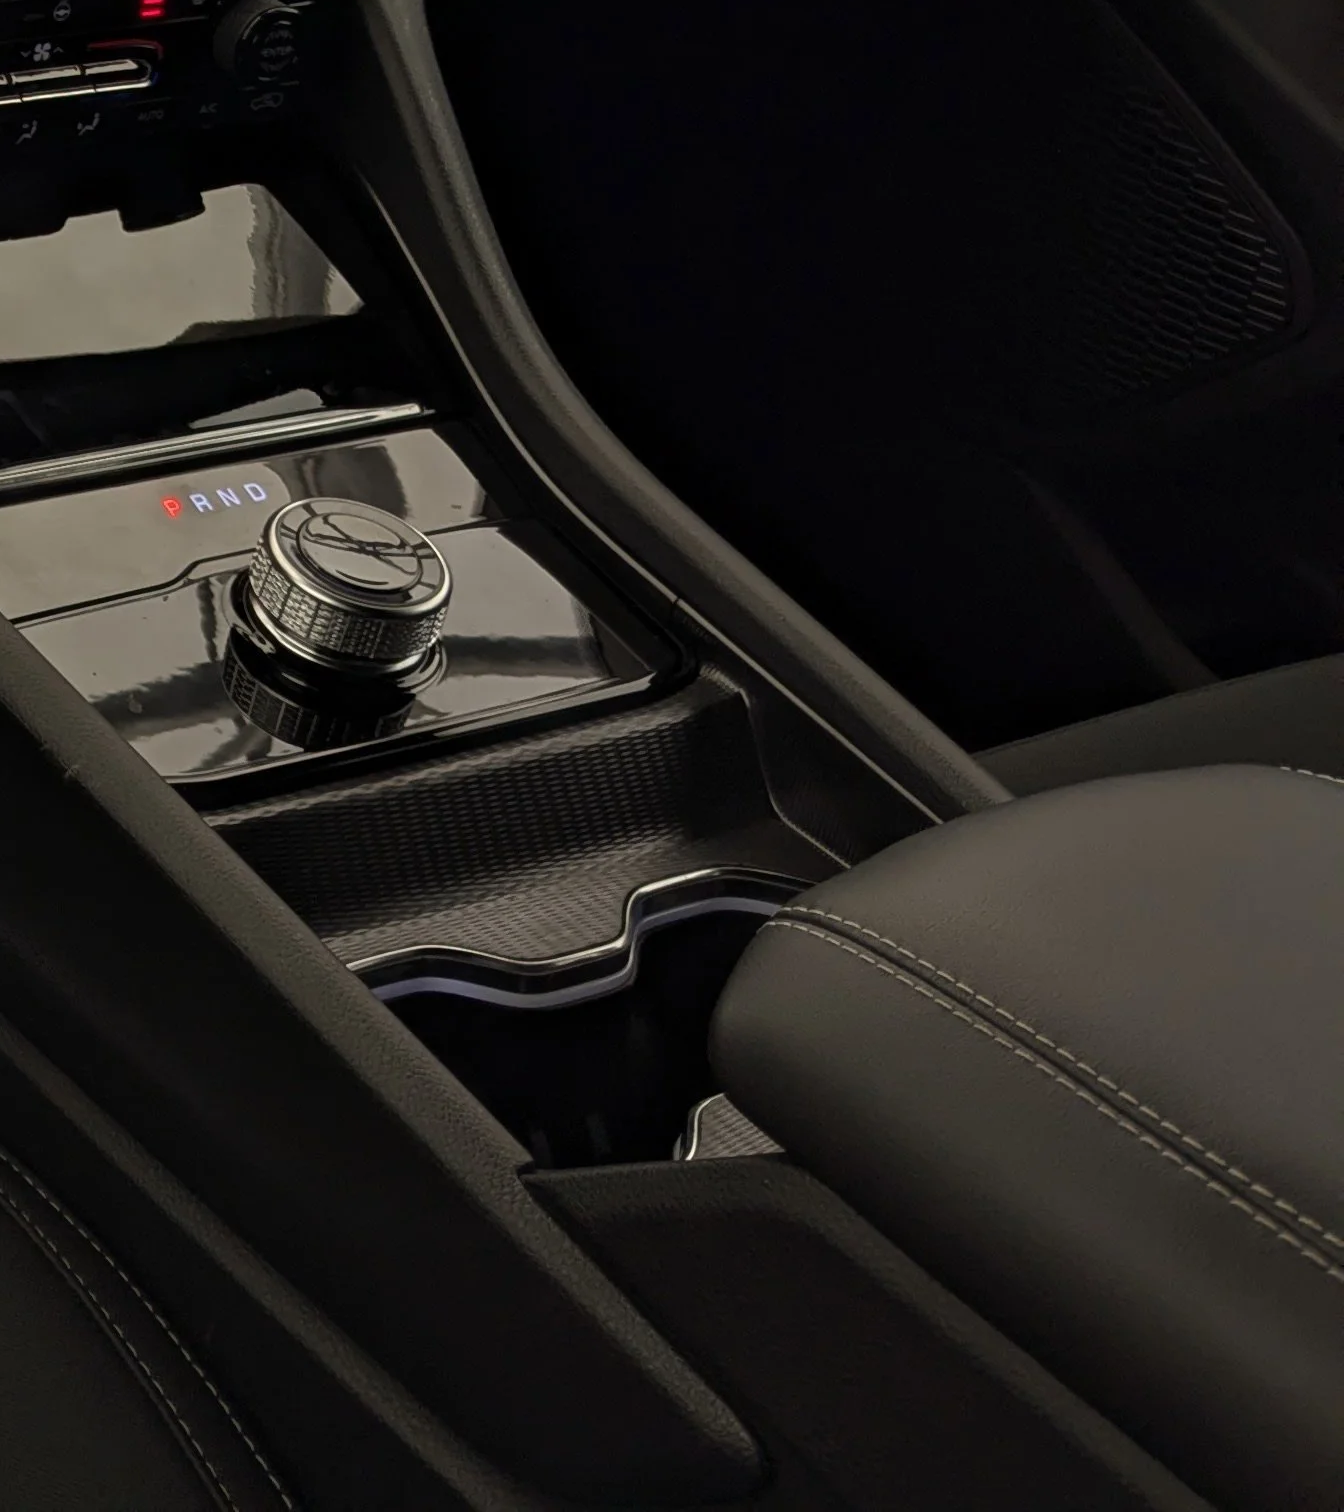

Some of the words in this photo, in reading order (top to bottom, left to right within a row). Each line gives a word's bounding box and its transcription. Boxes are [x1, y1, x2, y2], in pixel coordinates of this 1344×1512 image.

[137, 109, 164, 121] AUTO
[162, 496, 182, 519] P
[189, 493, 215, 513] R
[216, 487, 241, 507] N
[243, 482, 268, 502] D
